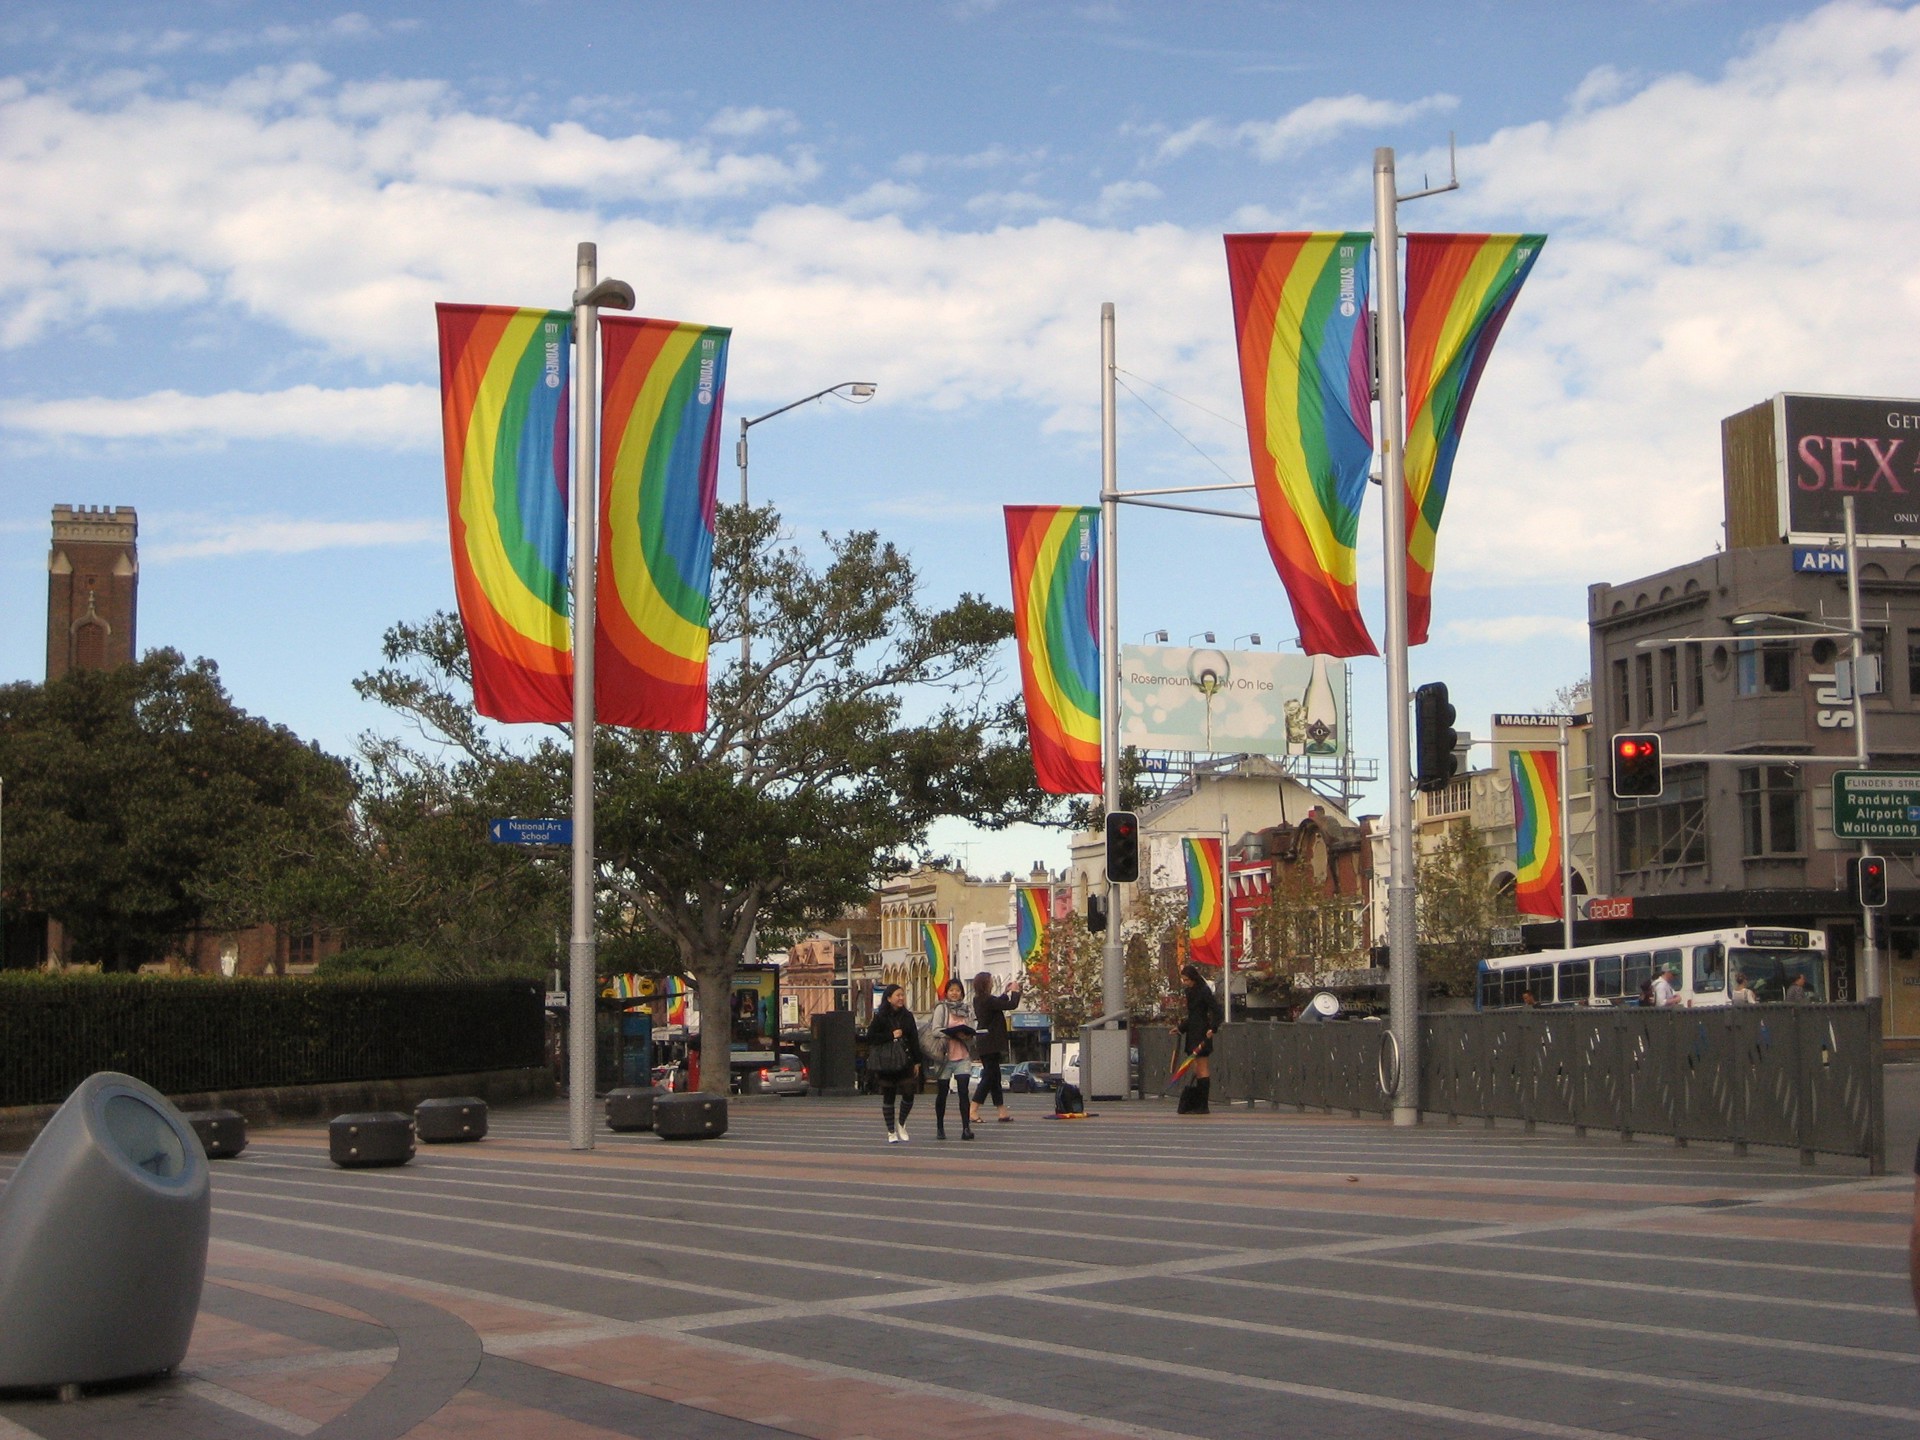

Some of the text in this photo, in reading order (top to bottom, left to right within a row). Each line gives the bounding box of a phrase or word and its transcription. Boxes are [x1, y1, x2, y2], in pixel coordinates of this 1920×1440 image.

[1341, 267, 1355, 302] SYDNEY
[546, 342, 559, 374] SYDNEY
[699, 359, 713, 392] SYDNEY
[1887, 412, 1920, 429] GET
[1797, 434, 1909, 493] SEX
[1893, 513, 1919, 524] ONLY
[1802, 552, 1844, 570] APN
[1131, 673, 1192, 686] Rosemount
[1237, 678, 1254, 690] On
[1256, 680, 1274, 691] Ice
[1847, 779, 1893, 787] FLINDERS
[1848, 794, 1909, 805] Randwick
[1856, 808, 1902, 821] Airport
[509, 822, 562, 831] National Art
[1843, 822, 1917, 836] Wollongong
[521, 832, 549, 840] School
[1788, 933, 1804, 946] 352
